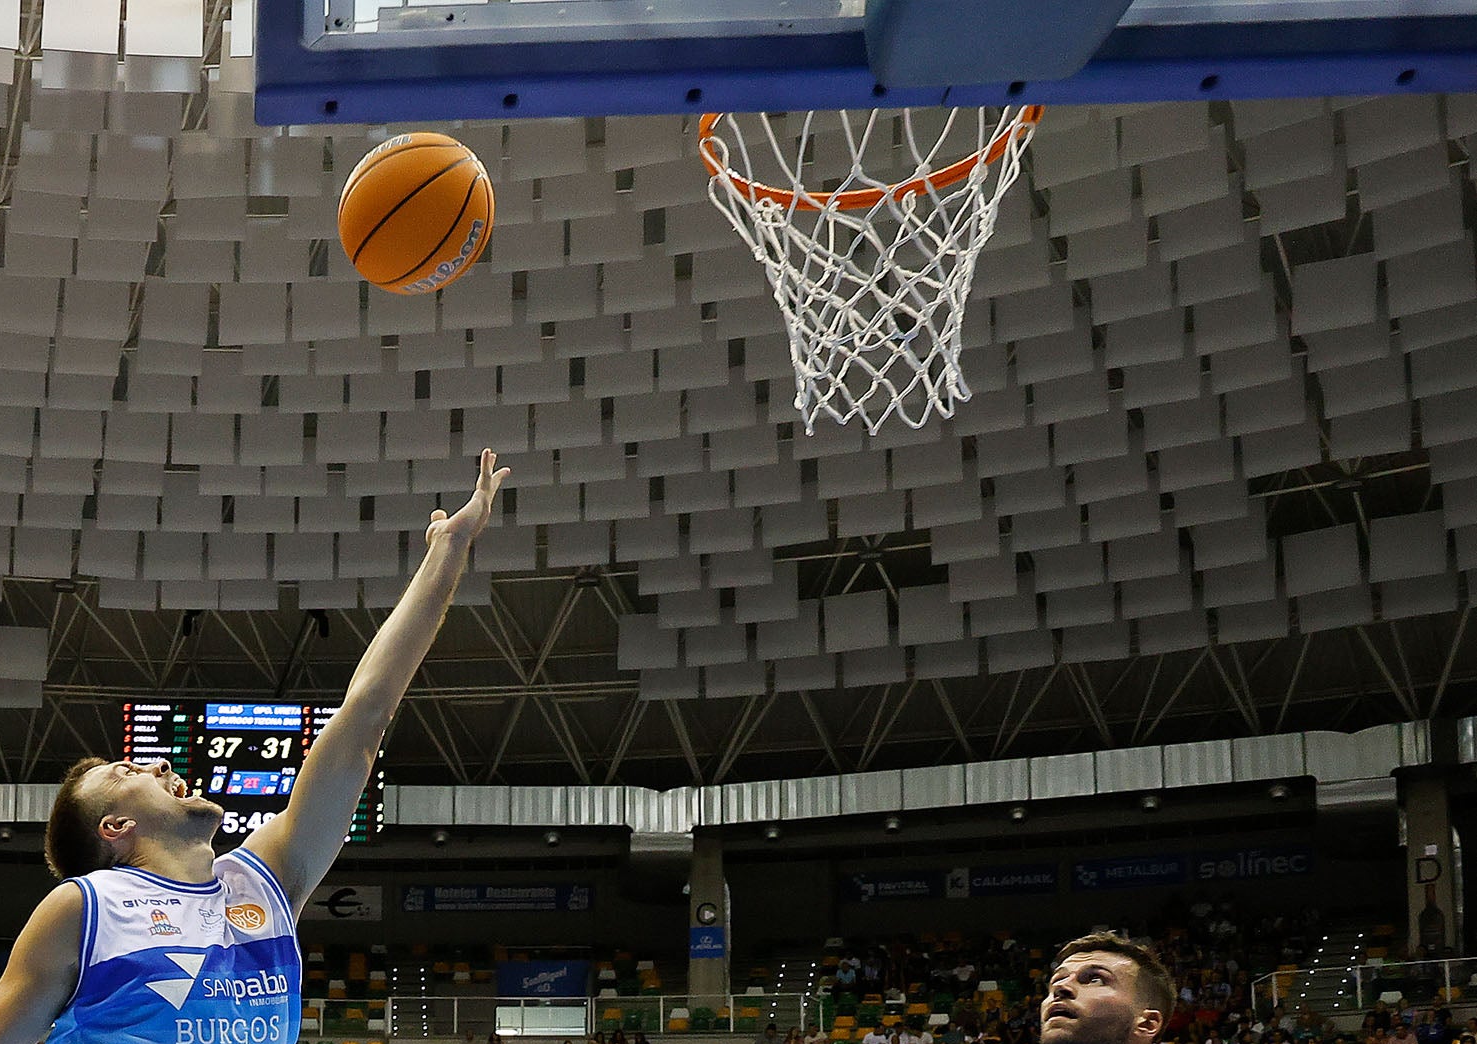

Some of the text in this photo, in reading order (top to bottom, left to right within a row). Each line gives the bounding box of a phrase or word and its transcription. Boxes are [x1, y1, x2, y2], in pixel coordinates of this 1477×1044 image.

[208, 736, 296, 759] 37 31
[211, 776, 223, 791] 0
[281, 777, 291, 792] 1
[1414, 857, 1441, 885] D
[123, 898, 181, 908] GIVOVA
[697, 902, 717, 926] C
